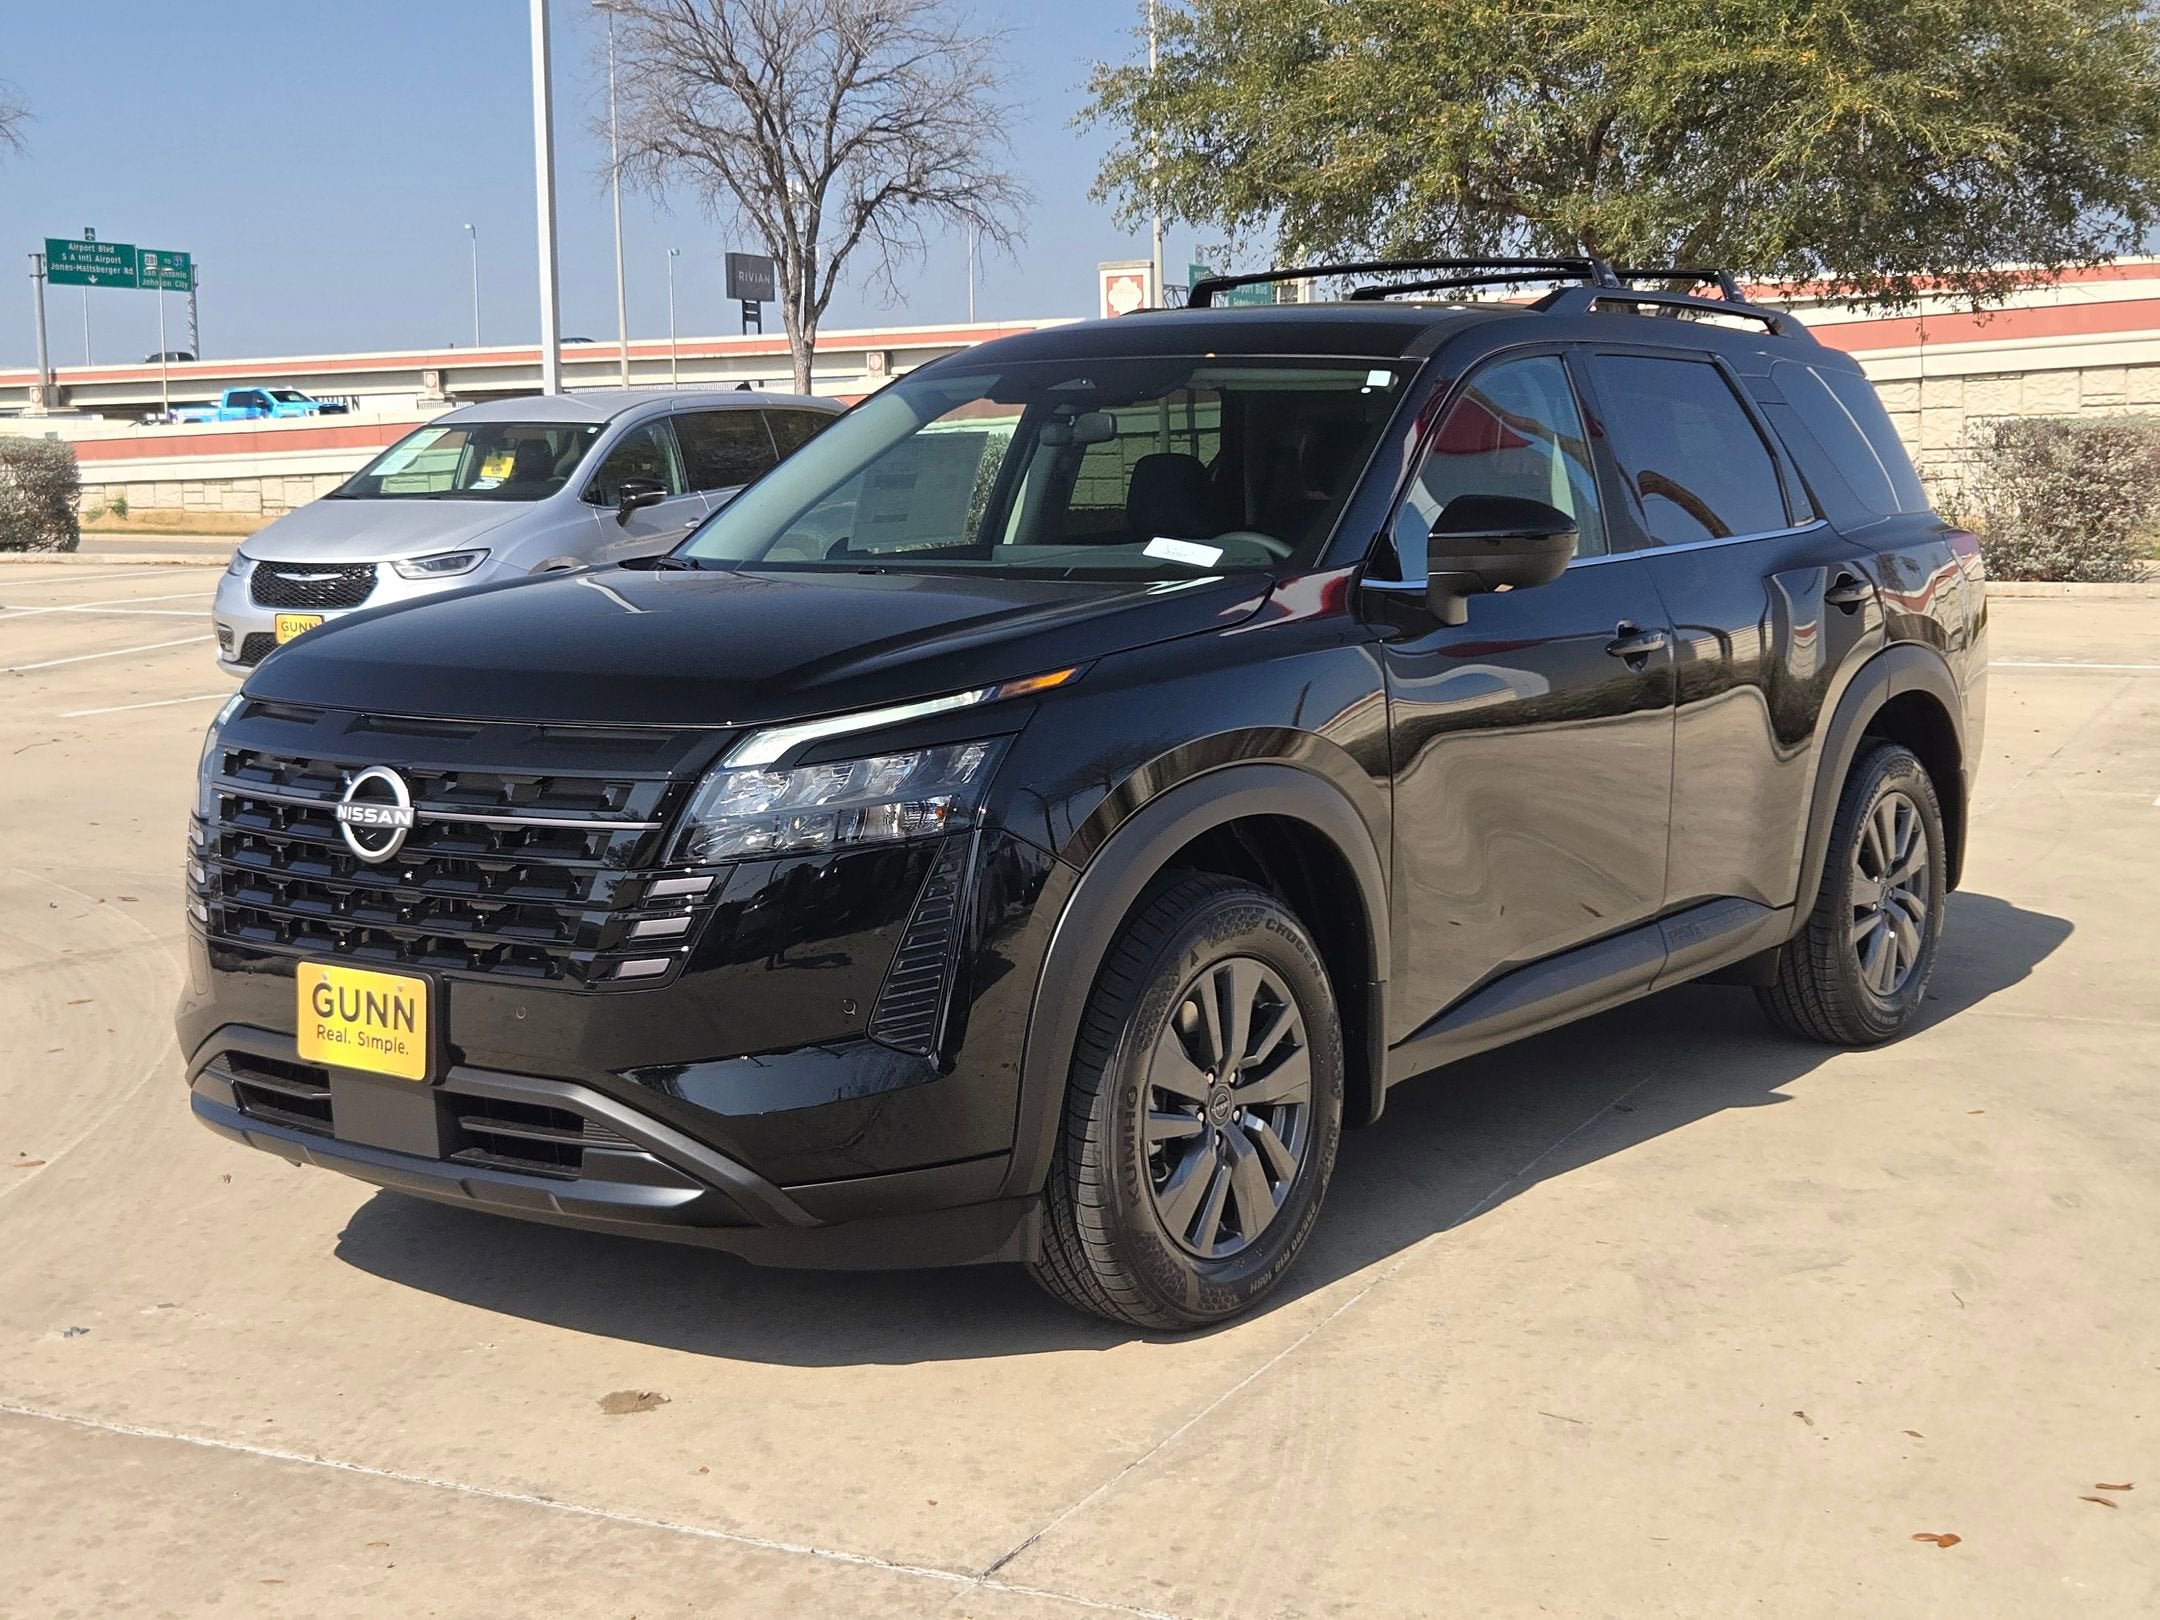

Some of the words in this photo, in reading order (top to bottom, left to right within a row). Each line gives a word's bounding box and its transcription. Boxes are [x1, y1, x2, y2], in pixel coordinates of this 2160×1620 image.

[68, 242, 95, 253] Airport
[98, 244, 115, 254] Blvd
[95, 255, 122, 266] Airport
[123, 267, 135, 275] Rd
[738, 271, 771, 285] RIVIAN
[336, 804, 411, 826] NISSAN
[312, 981, 415, 1034] GUNN
[317, 1024, 351, 1045] Real.
[357, 1031, 409, 1055] Simple.
[1124, 1084, 1142, 1208] KUMHO
